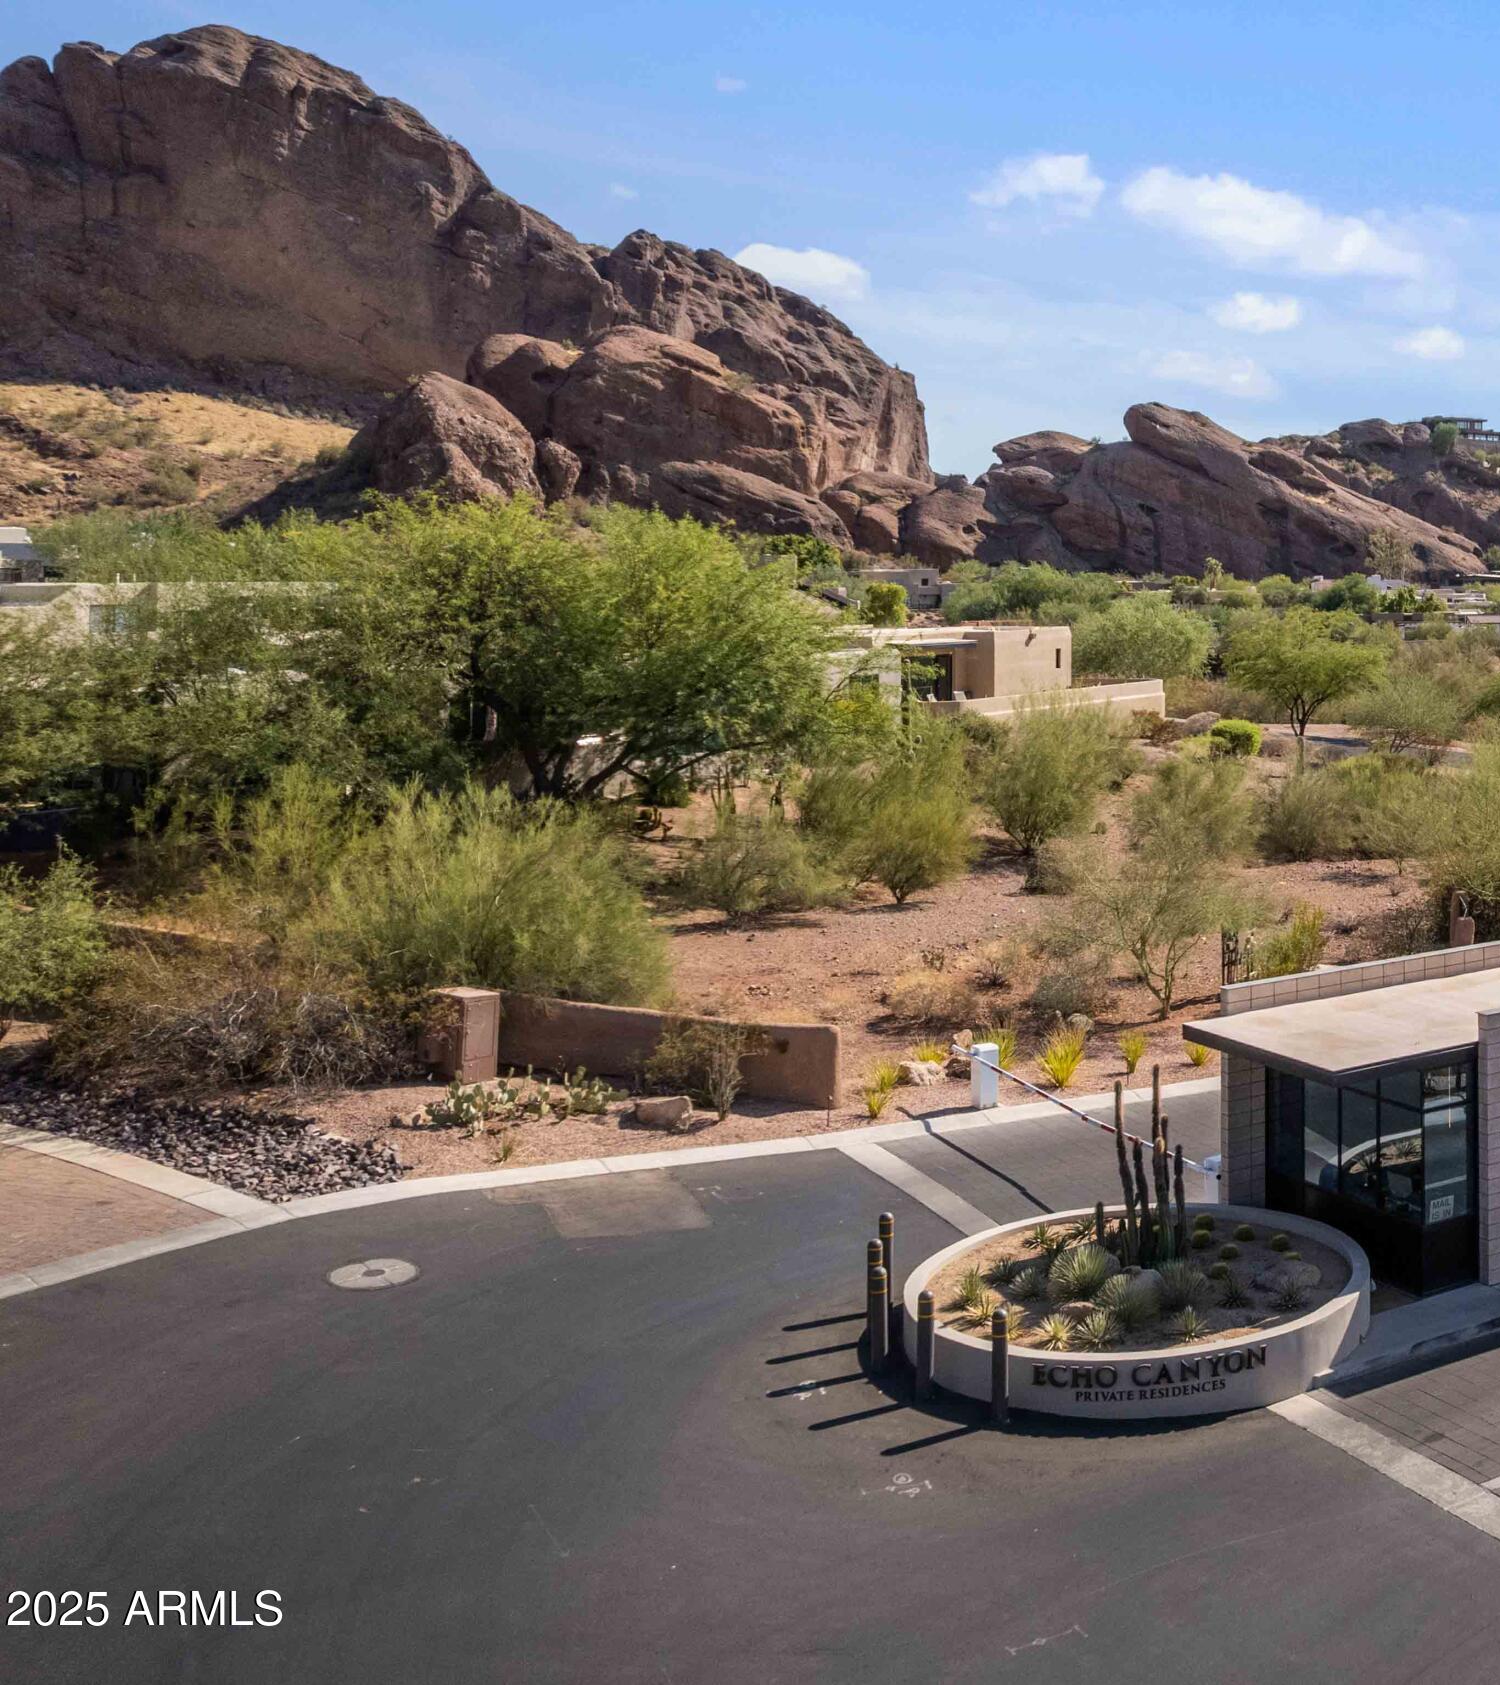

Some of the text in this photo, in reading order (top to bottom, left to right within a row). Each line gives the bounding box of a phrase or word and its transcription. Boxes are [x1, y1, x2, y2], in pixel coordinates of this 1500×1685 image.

[1432, 1198, 1452, 1209] MAIL
[1443, 1208, 1451, 1217] IN
[1031, 1343, 1268, 1389] ECHO CANYON
[1075, 1378, 1226, 1402] PRIVATE RESIDENCES
